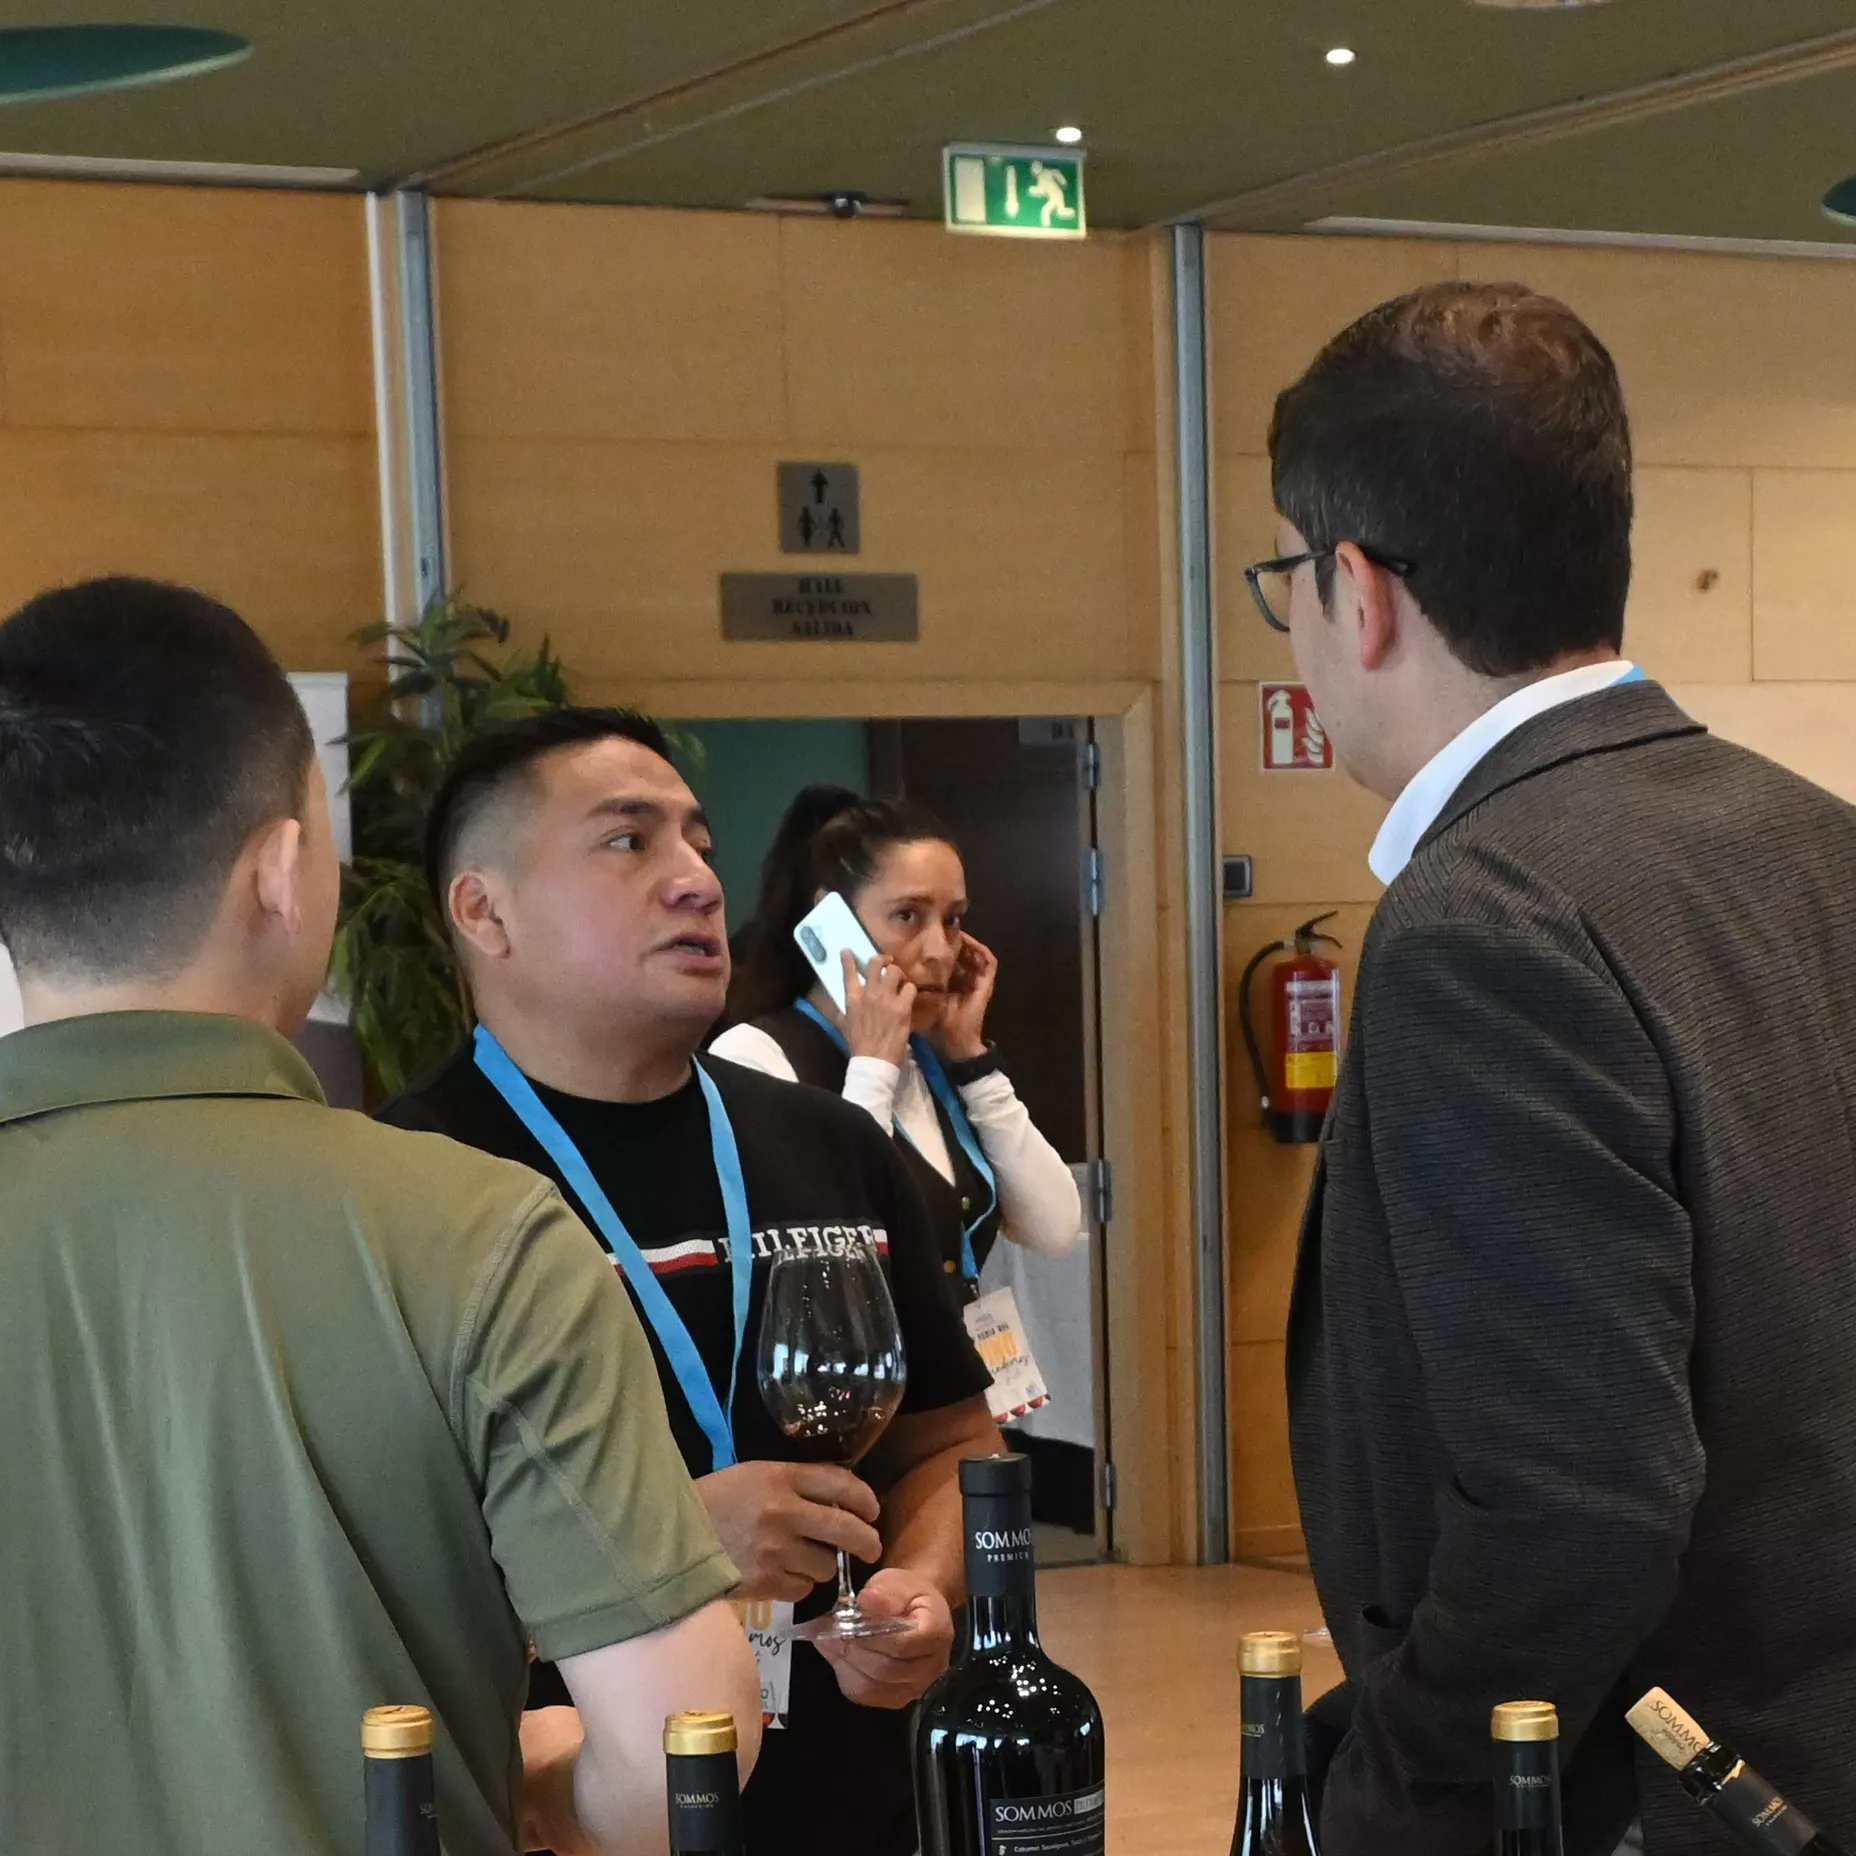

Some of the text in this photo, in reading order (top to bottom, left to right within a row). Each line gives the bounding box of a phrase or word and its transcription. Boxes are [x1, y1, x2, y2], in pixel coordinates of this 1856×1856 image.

[975, 1528, 1031, 1549] SOMMO
[1651, 1700, 1704, 1753] SOMMO
[995, 1800, 1073, 1822] SOMMOS
